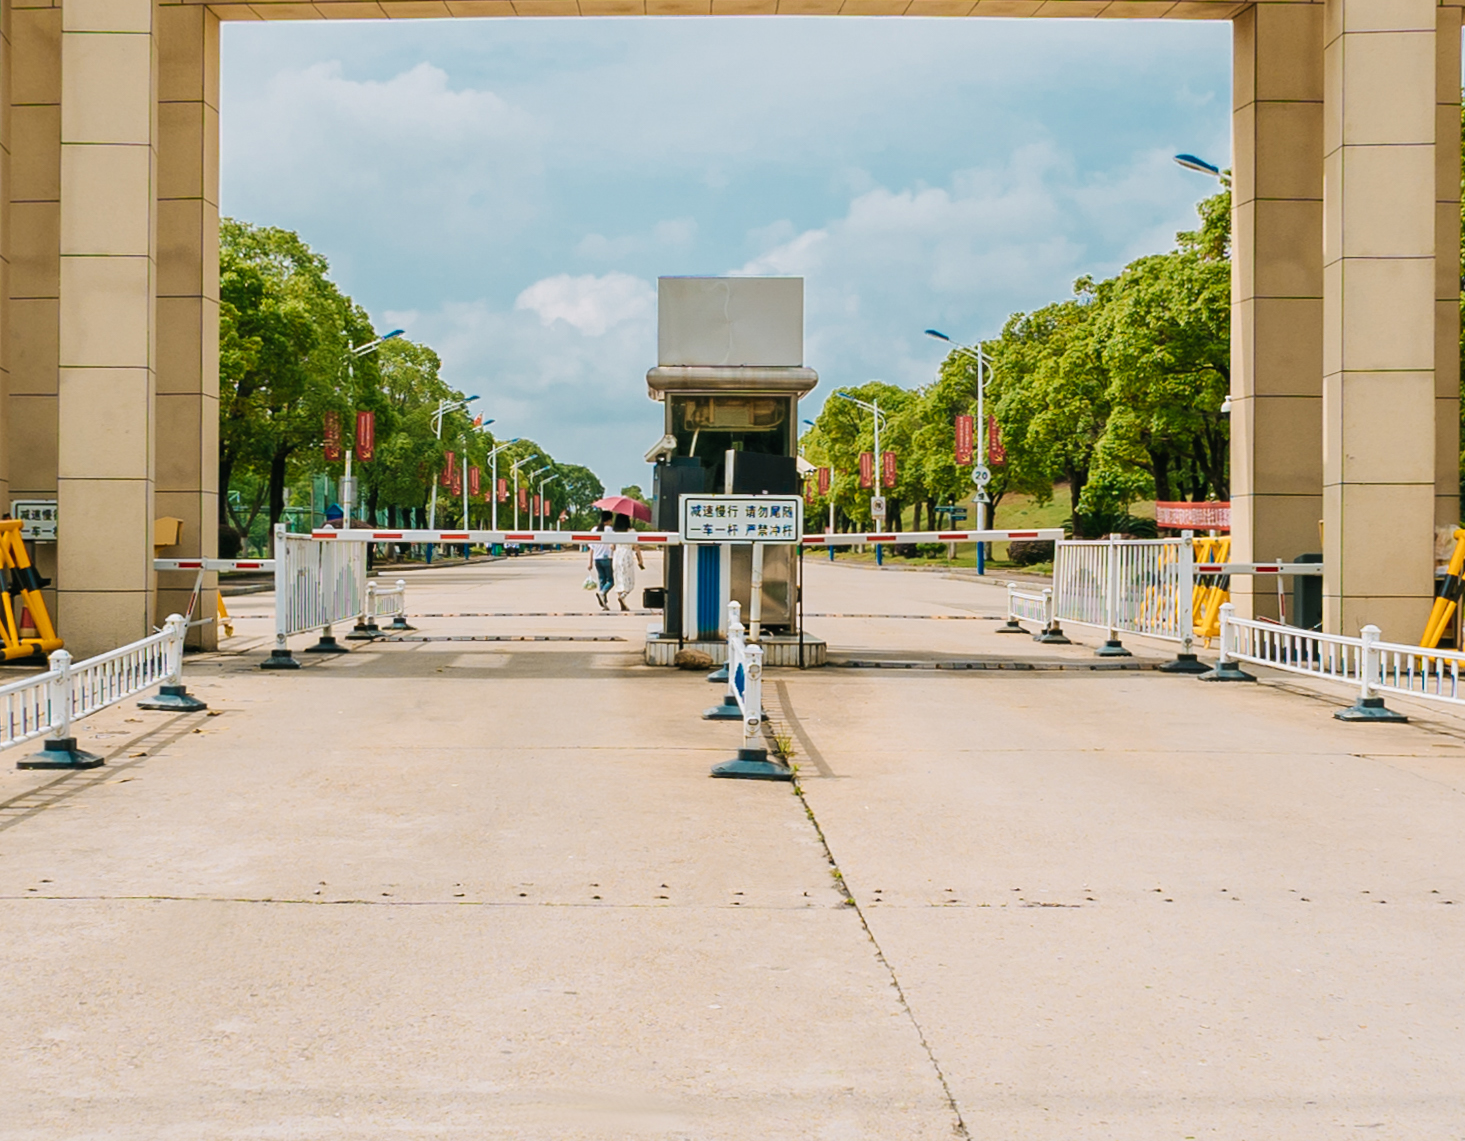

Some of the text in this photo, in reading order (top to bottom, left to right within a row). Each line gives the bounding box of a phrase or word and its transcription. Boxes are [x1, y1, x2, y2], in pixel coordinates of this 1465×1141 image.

[975, 471, 988, 480] 20
[690, 505, 793, 518] 减速慢行 请勿尾随
[690, 523, 793, 536] 一车一杆 严禁冲杆
